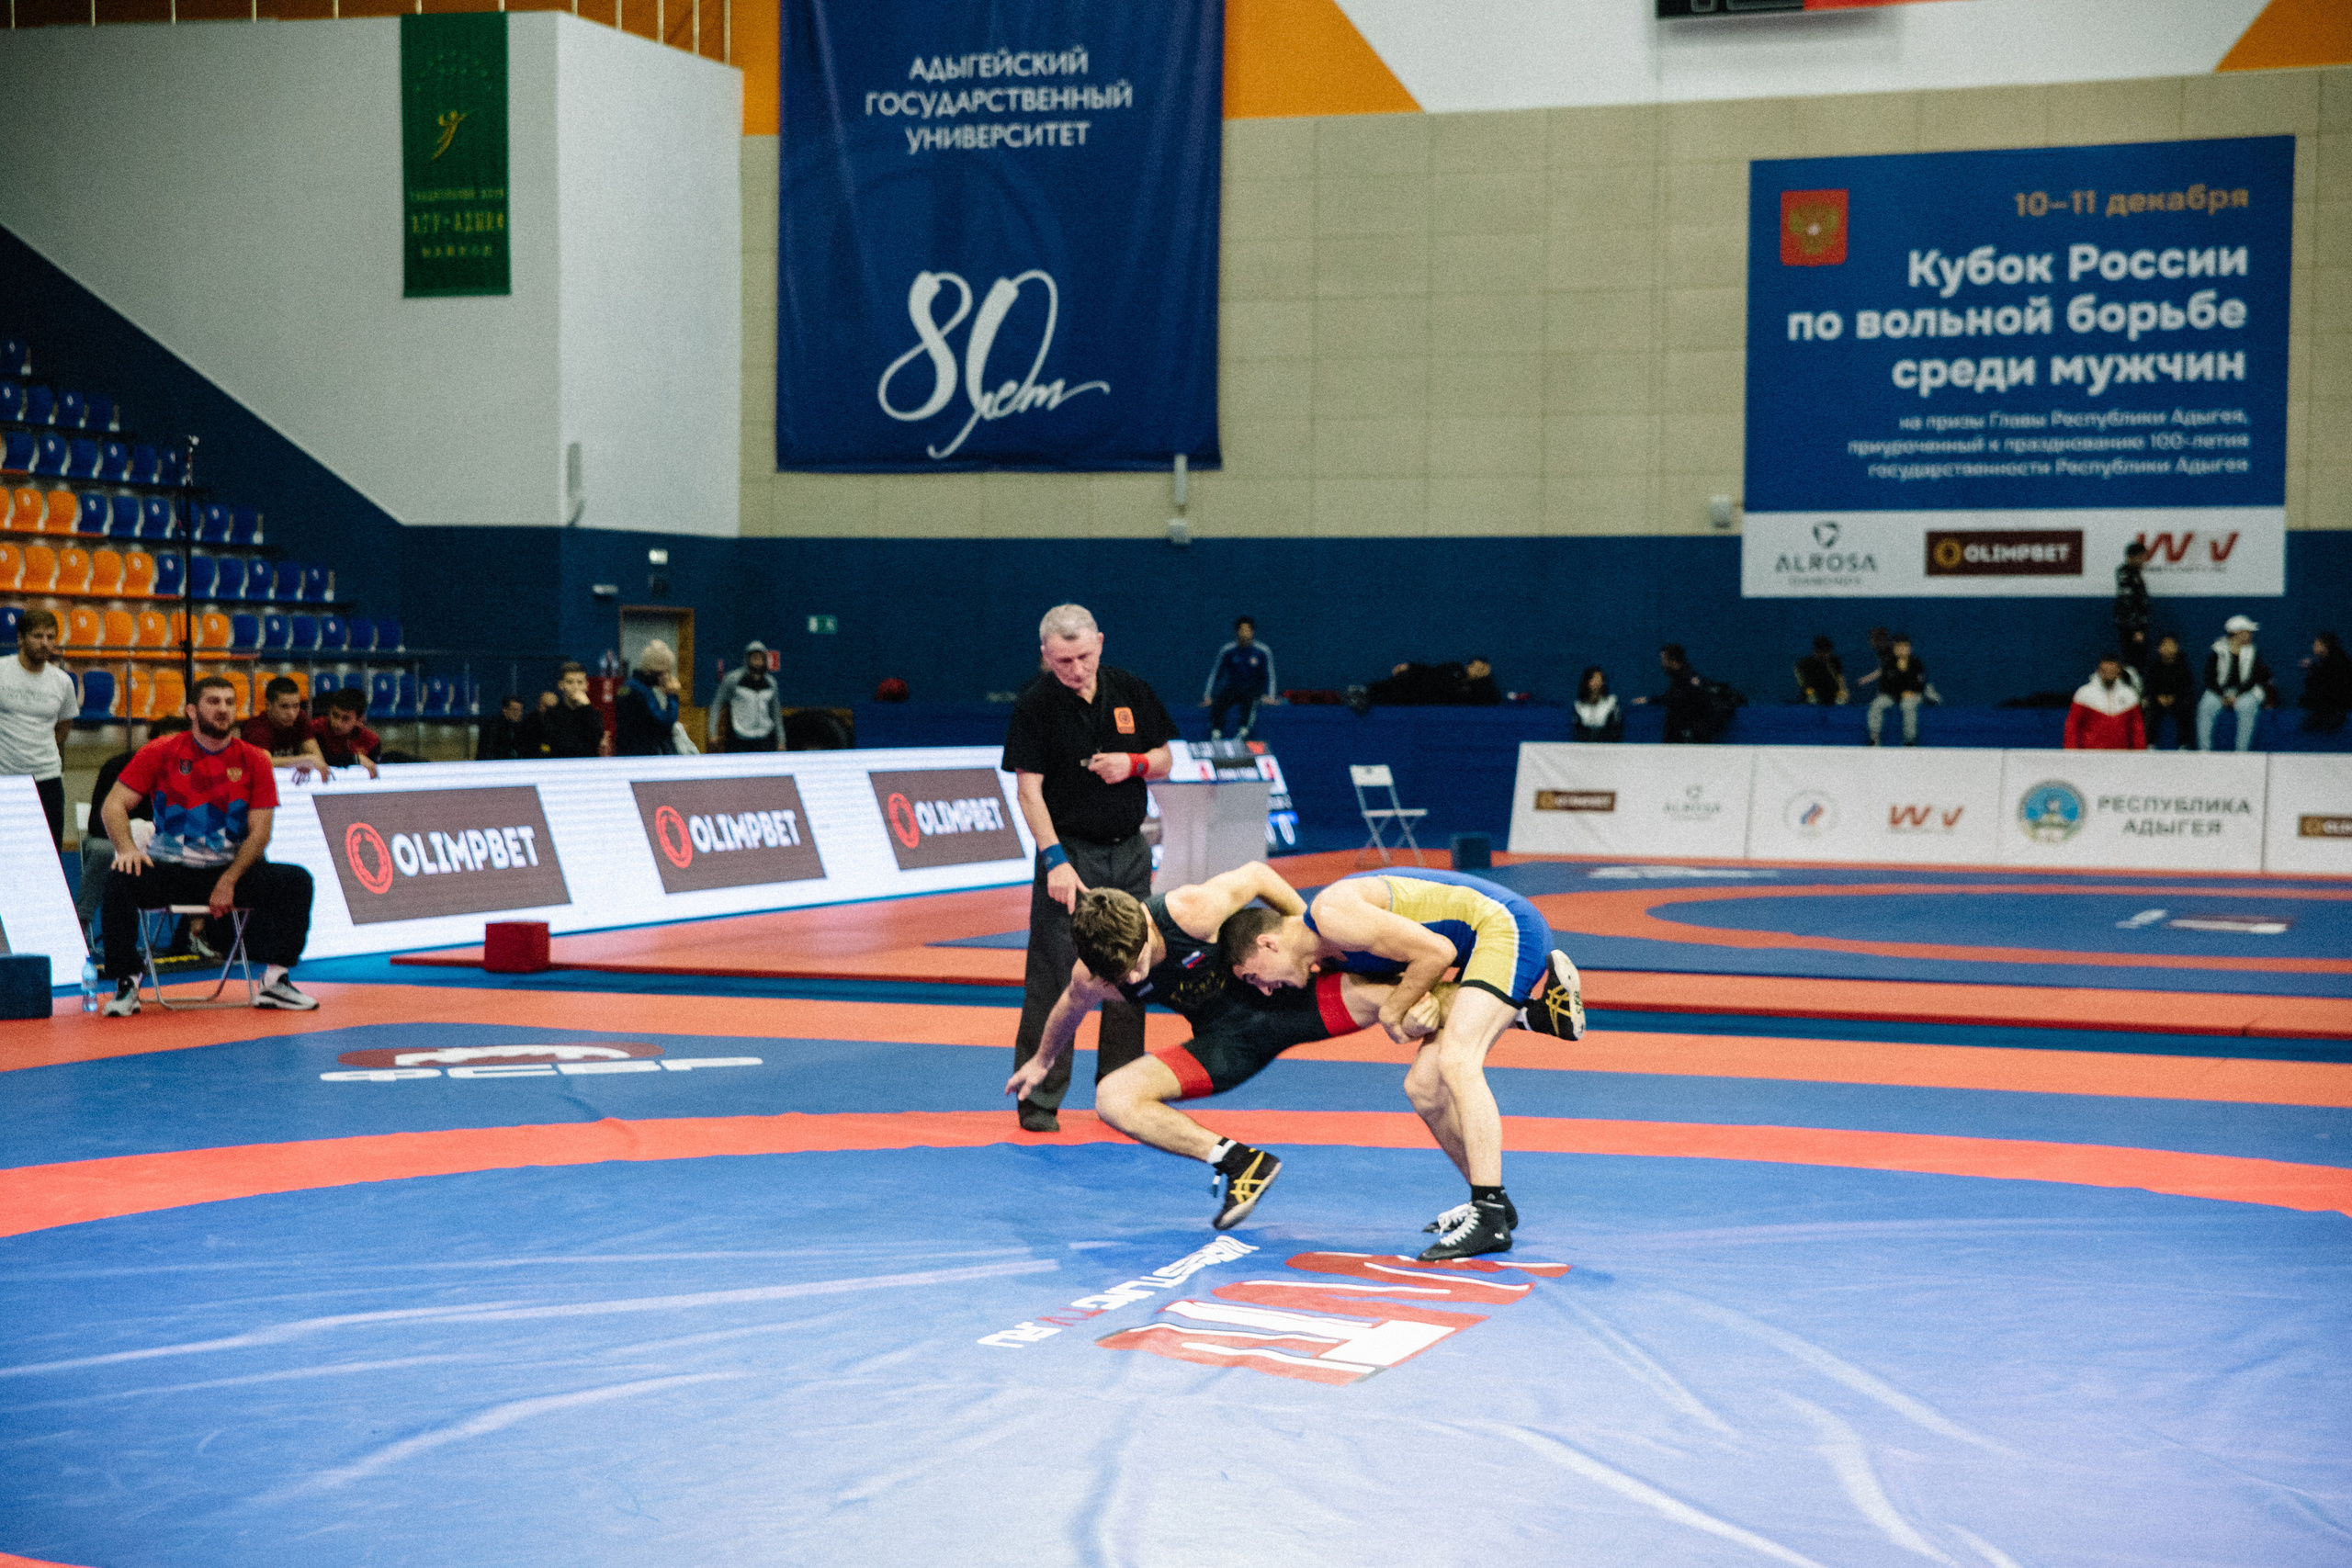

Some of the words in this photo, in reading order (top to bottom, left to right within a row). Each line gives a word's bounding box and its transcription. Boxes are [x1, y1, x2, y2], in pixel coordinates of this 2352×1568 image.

[909, 45, 1089, 83] АДЫГЕЙСКИЙ
[865, 78, 1133, 118] ГОСУДАРСТВЕННЫЙ
[905, 120, 1091, 155] УНИВЕРСИТЕТ
[2105, 184, 2249, 217] декабря
[1908, 245, 2053, 298] Кубок
[2068, 243, 2248, 282] России
[1788, 311, 1843, 341] по
[1856, 296, 2052, 339] вольной
[2066, 289, 2247, 341] борьбе
[877, 269, 1058, 421] 80
[1892, 356, 2036, 397] среди
[2050, 351, 2245, 395] мужчин
[1774, 553, 1877, 573] ALROSA
[914, 795, 1007, 836] OLIMPBET
[2098, 795, 2252, 816] РЕСПУБЛИКА
[688, 808, 800, 852] OLIMPBET
[2123, 818, 2222, 837] АДЫГЕЯ
[391, 826, 539, 876] OLIMPBET
